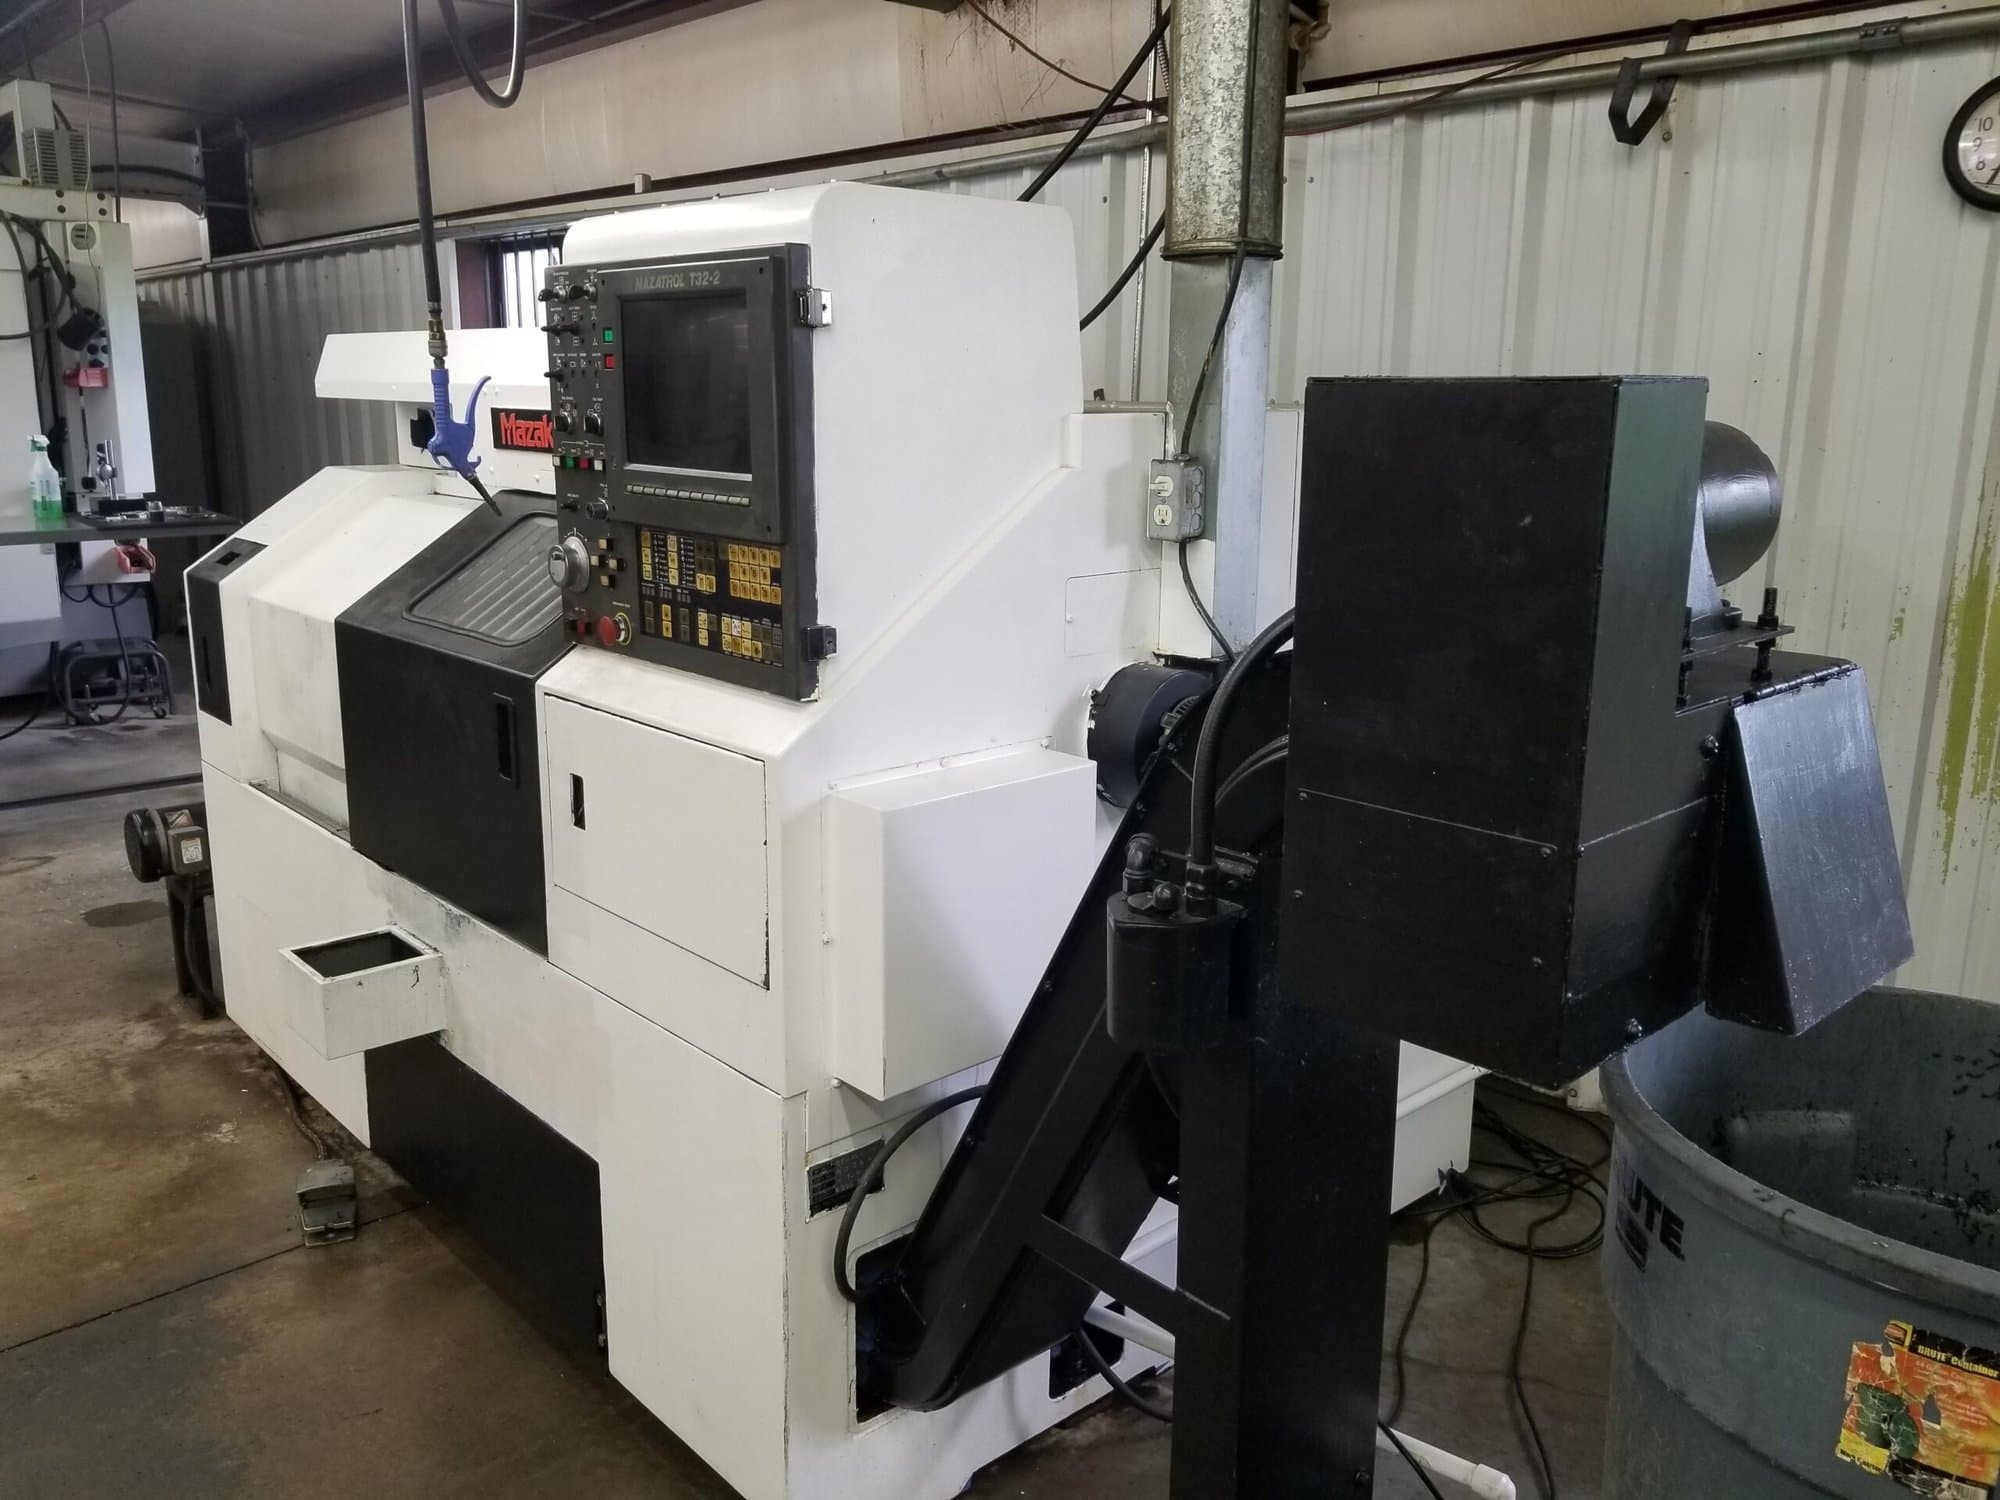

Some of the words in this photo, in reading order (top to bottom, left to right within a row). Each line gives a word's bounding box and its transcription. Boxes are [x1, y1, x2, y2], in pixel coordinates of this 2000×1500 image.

[1978, 116, 1994, 132] 10
[1972, 137, 1983, 152] 9
[689, 270, 721, 287] T32-2
[499, 412, 554, 448] Mazak
